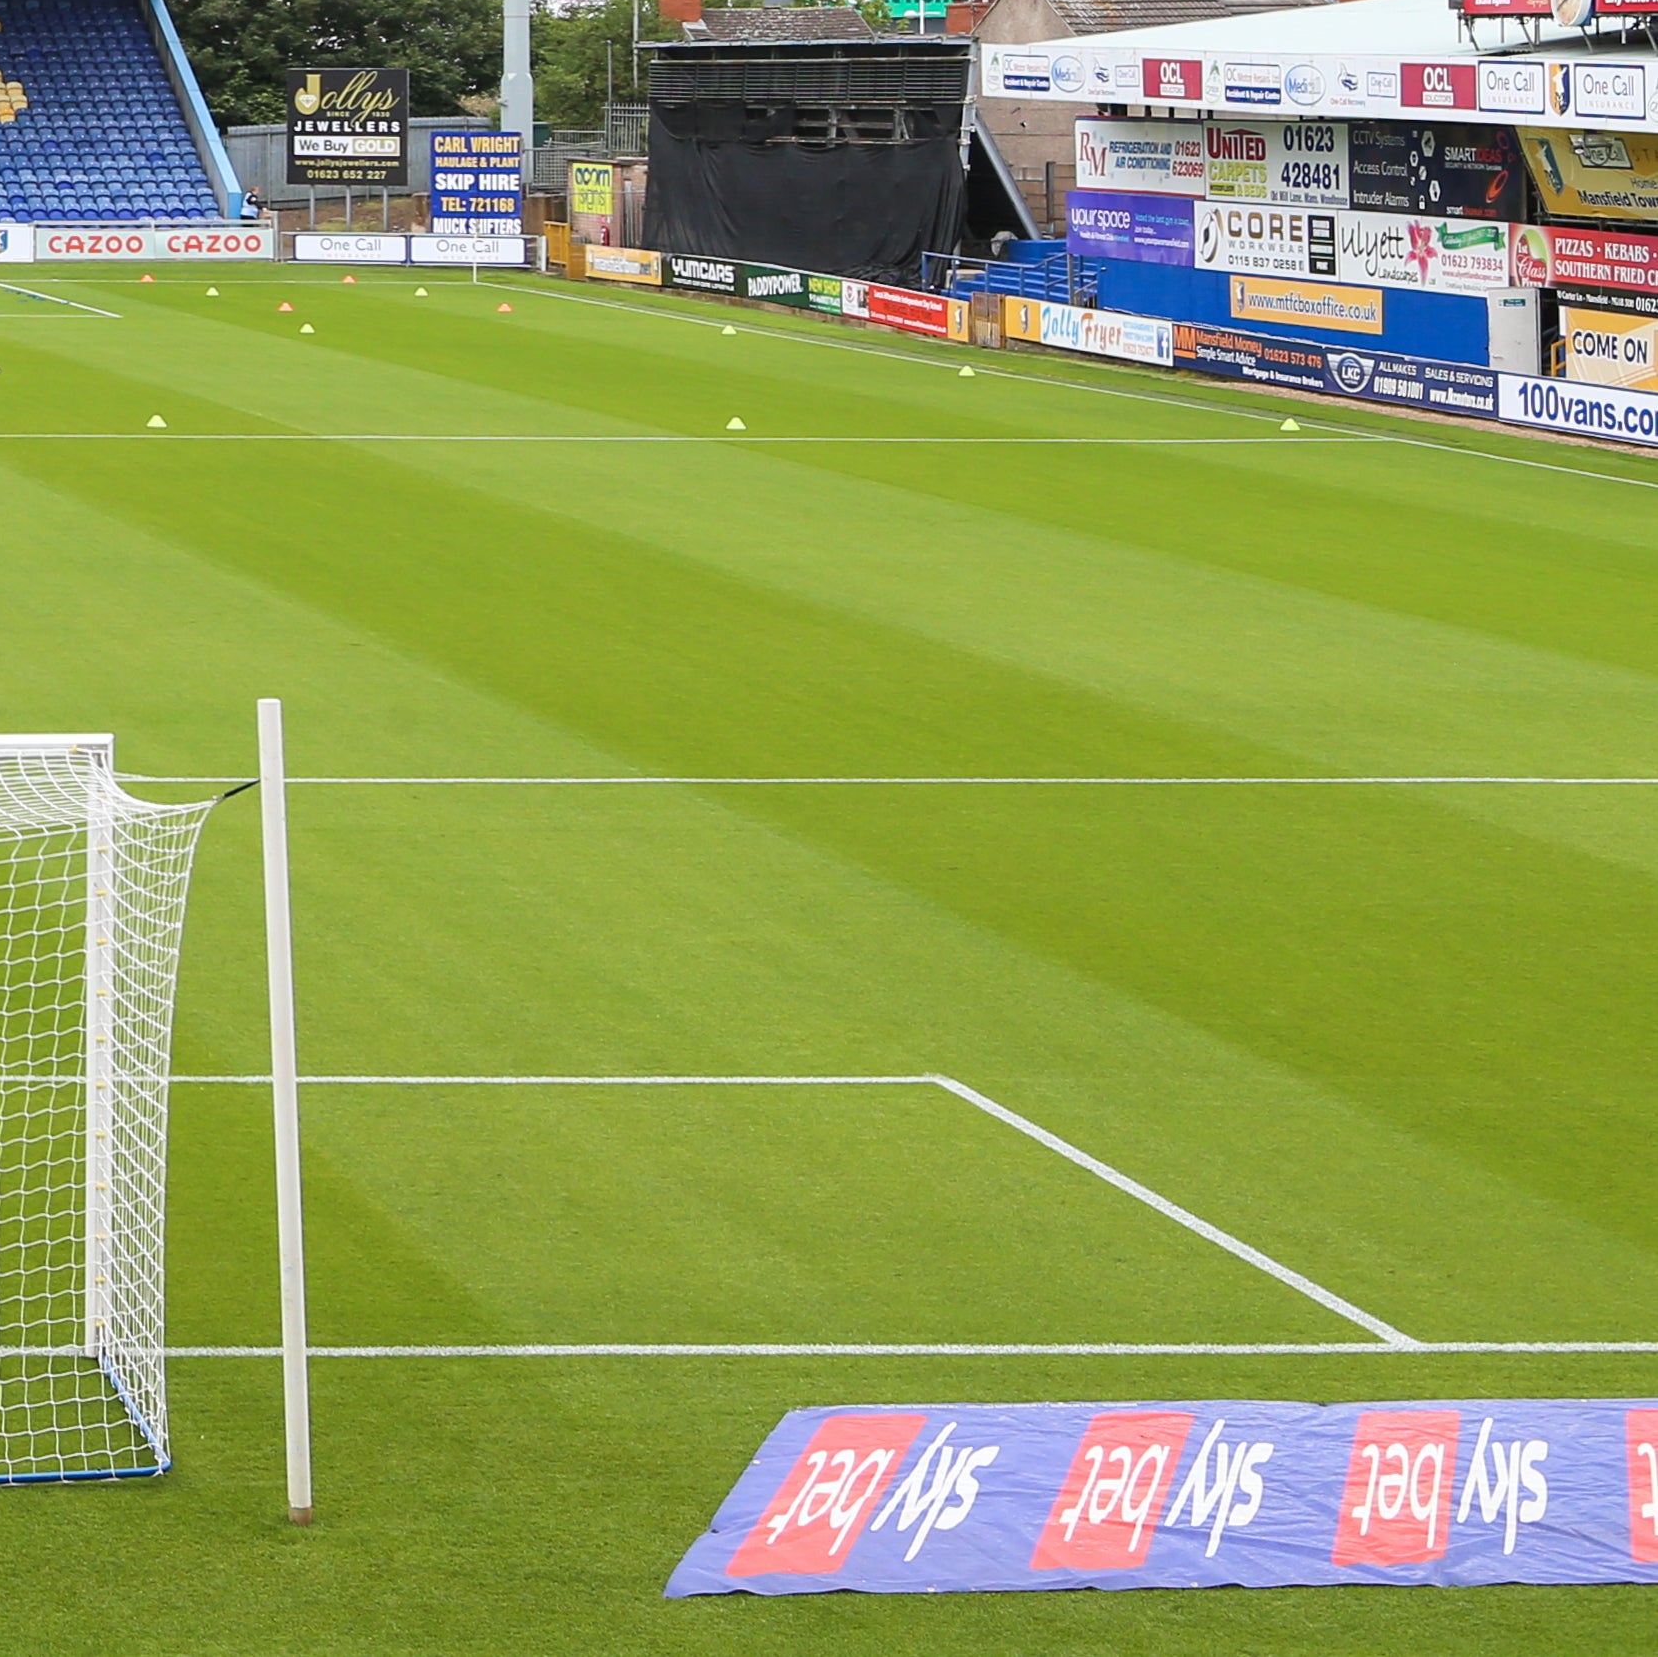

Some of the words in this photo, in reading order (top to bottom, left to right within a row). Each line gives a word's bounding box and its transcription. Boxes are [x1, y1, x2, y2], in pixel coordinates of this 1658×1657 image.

[1160, 62, 1184, 84] OCL
[1423, 67, 1453, 91] OCL
[1487, 70, 1511, 91] One
[1514, 71, 1534, 92] Call
[1583, 73, 1608, 95] One
[1612, 75, 1634, 97] Call
[1488, 96, 1535, 105] INSURANCE
[1584, 100, 1635, 109] INSURANCE
[294, 121, 401, 133] JEWELLERS
[299, 139, 320, 151] We
[324, 139, 349, 154] Buy
[355, 140, 397, 153] GOLD
[434, 136, 468, 153] CARL
[470, 136, 521, 154] WRIGHT
[1109, 141, 1159, 154] REFRIGERATION
[1174, 140, 1201, 157] 01623
[1207, 127, 1267, 160] UNITED
[1284, 125, 1335, 153] 01623
[1353, 130, 1374, 145] CCTV
[1375, 132, 1406, 149] Systems
[435, 156, 478, 168] HAULAGE
[489, 157, 521, 168] PLANT
[1127, 157, 1171, 171] CONDITIONING
[1209, 161, 1268, 183] CARPETS
[1354, 160, 1380, 176] Access
[1382, 161, 1409, 177] Control
[307, 170, 340, 179] 01623
[366, 170, 387, 180] 227
[435, 173, 475, 191] SKIP
[478, 173, 520, 191] HIRE
[1281, 162, 1341, 190] 428481
[1631, 177, 1658, 190] Home
[469, 197, 515, 213] 721168
[1353, 190, 1383, 206] Intruder
[1385, 191, 1410, 208] Alarms
[1577, 189, 1632, 208] Mansfield
[433, 217, 467, 234] MUCK
[1228, 210, 1304, 242] CORE
[48, 235, 144, 253] CAZOO
[167, 234, 262, 253] CAZOO
[320, 238, 351, 251] One
[355, 237, 383, 251] Call
[436, 239, 465, 253] One
[472, 239, 500, 253] Call
[1228, 240, 1304, 254] WORKWEAR
[1555, 238, 1594, 258] PIZZAS
[1604, 242, 1650, 263] KEBABS
[672, 257, 736, 284] YUMCARS
[1228, 255, 1250, 267] 0115
[1253, 256, 1270, 268] 837
[1273, 258, 1296, 271] 0258
[1441, 254, 1468, 269] 01623
[1471, 256, 1504, 272] 793834
[1555, 260, 1612, 281] SOUTHERN
[1613, 265, 1645, 284] FRIED
[808, 277, 823, 290] NEW
[824, 280, 841, 293] SHOP
[1248, 291, 1377, 322] www.mtfcboxoffice.co.uk
[1042, 304, 1080, 346] Jolly
[1080, 312, 1122, 351] Fryer
[1174, 325, 1196, 351] MM
[1196, 330, 1234, 349] Mansfield
[1234, 338, 1262, 358] Money
[1572, 330, 1618, 360] COME
[1623, 337, 1648, 364] ON
[1196, 346, 1216, 362] Simple
[1216, 349, 1234, 364] Smart
[1234, 352, 1256, 367] Advice
[1264, 347, 1290, 363] 01623
[1291, 352, 1307, 366] 573
[1307, 354, 1323, 369] 476
[1242, 365, 1269, 381] Mortgage
[1275, 370, 1301, 386] Insurance
[1301, 374, 1324, 389] Brokers
[1341, 366, 1360, 381] LKC
[1424, 367, 1449, 382] SALES
[1456, 372, 1494, 388] SERVICING
[1518, 381, 1658, 437] 100vans.co
[872, 1421, 1000, 1562] sky
[1165, 1417, 1275, 1559] sky
[1457, 1417, 1548, 1555] sky
[768, 1448, 895, 1555] bet
[1061, 1443, 1170, 1553] bet
[1363, 1442, 1445, 1555] bet
